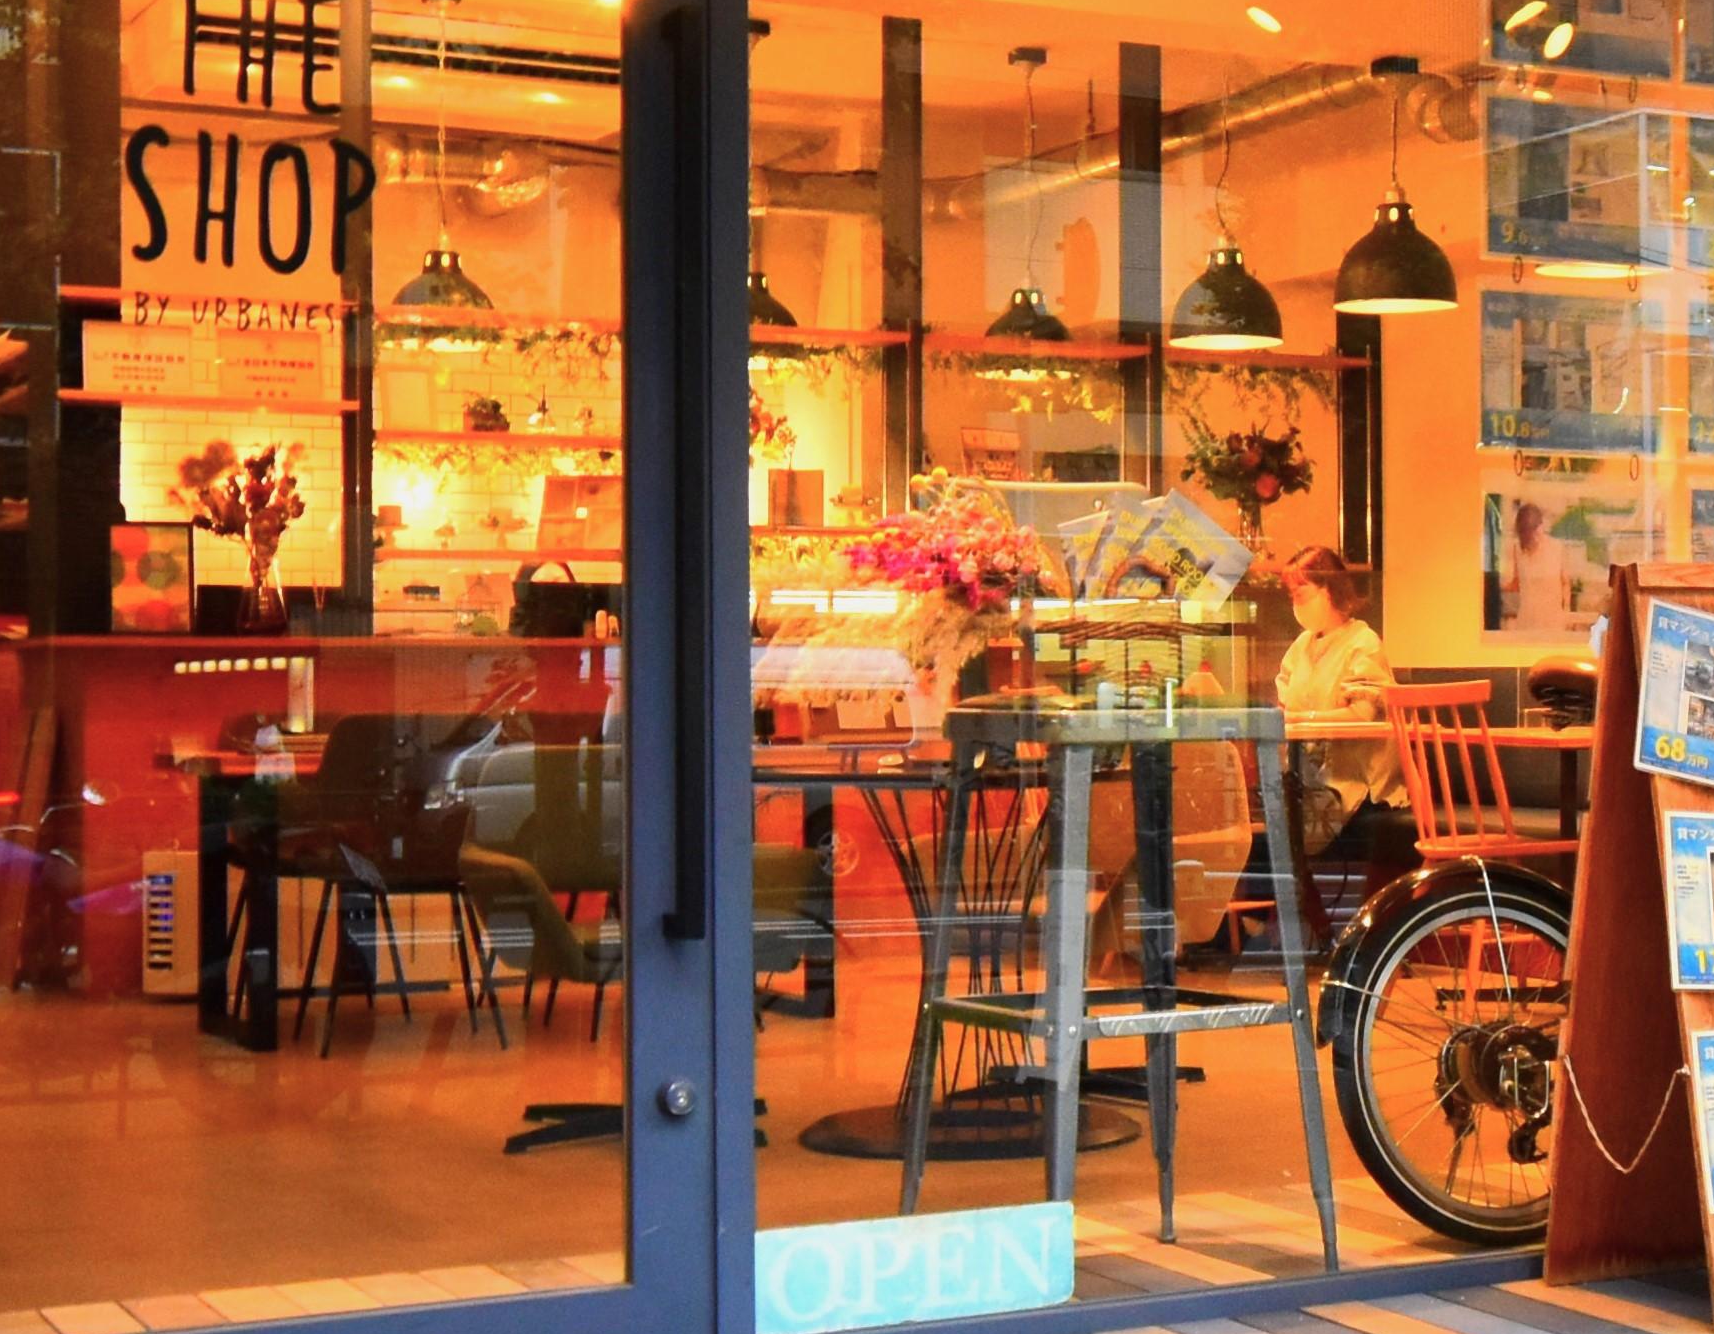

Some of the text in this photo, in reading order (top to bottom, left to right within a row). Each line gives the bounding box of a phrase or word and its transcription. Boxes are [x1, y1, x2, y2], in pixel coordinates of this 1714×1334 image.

[126, 125, 378, 276] SHOP
[135, 291, 359, 333] BY URBANEST
[767, 1213, 1067, 1323] OPEN
